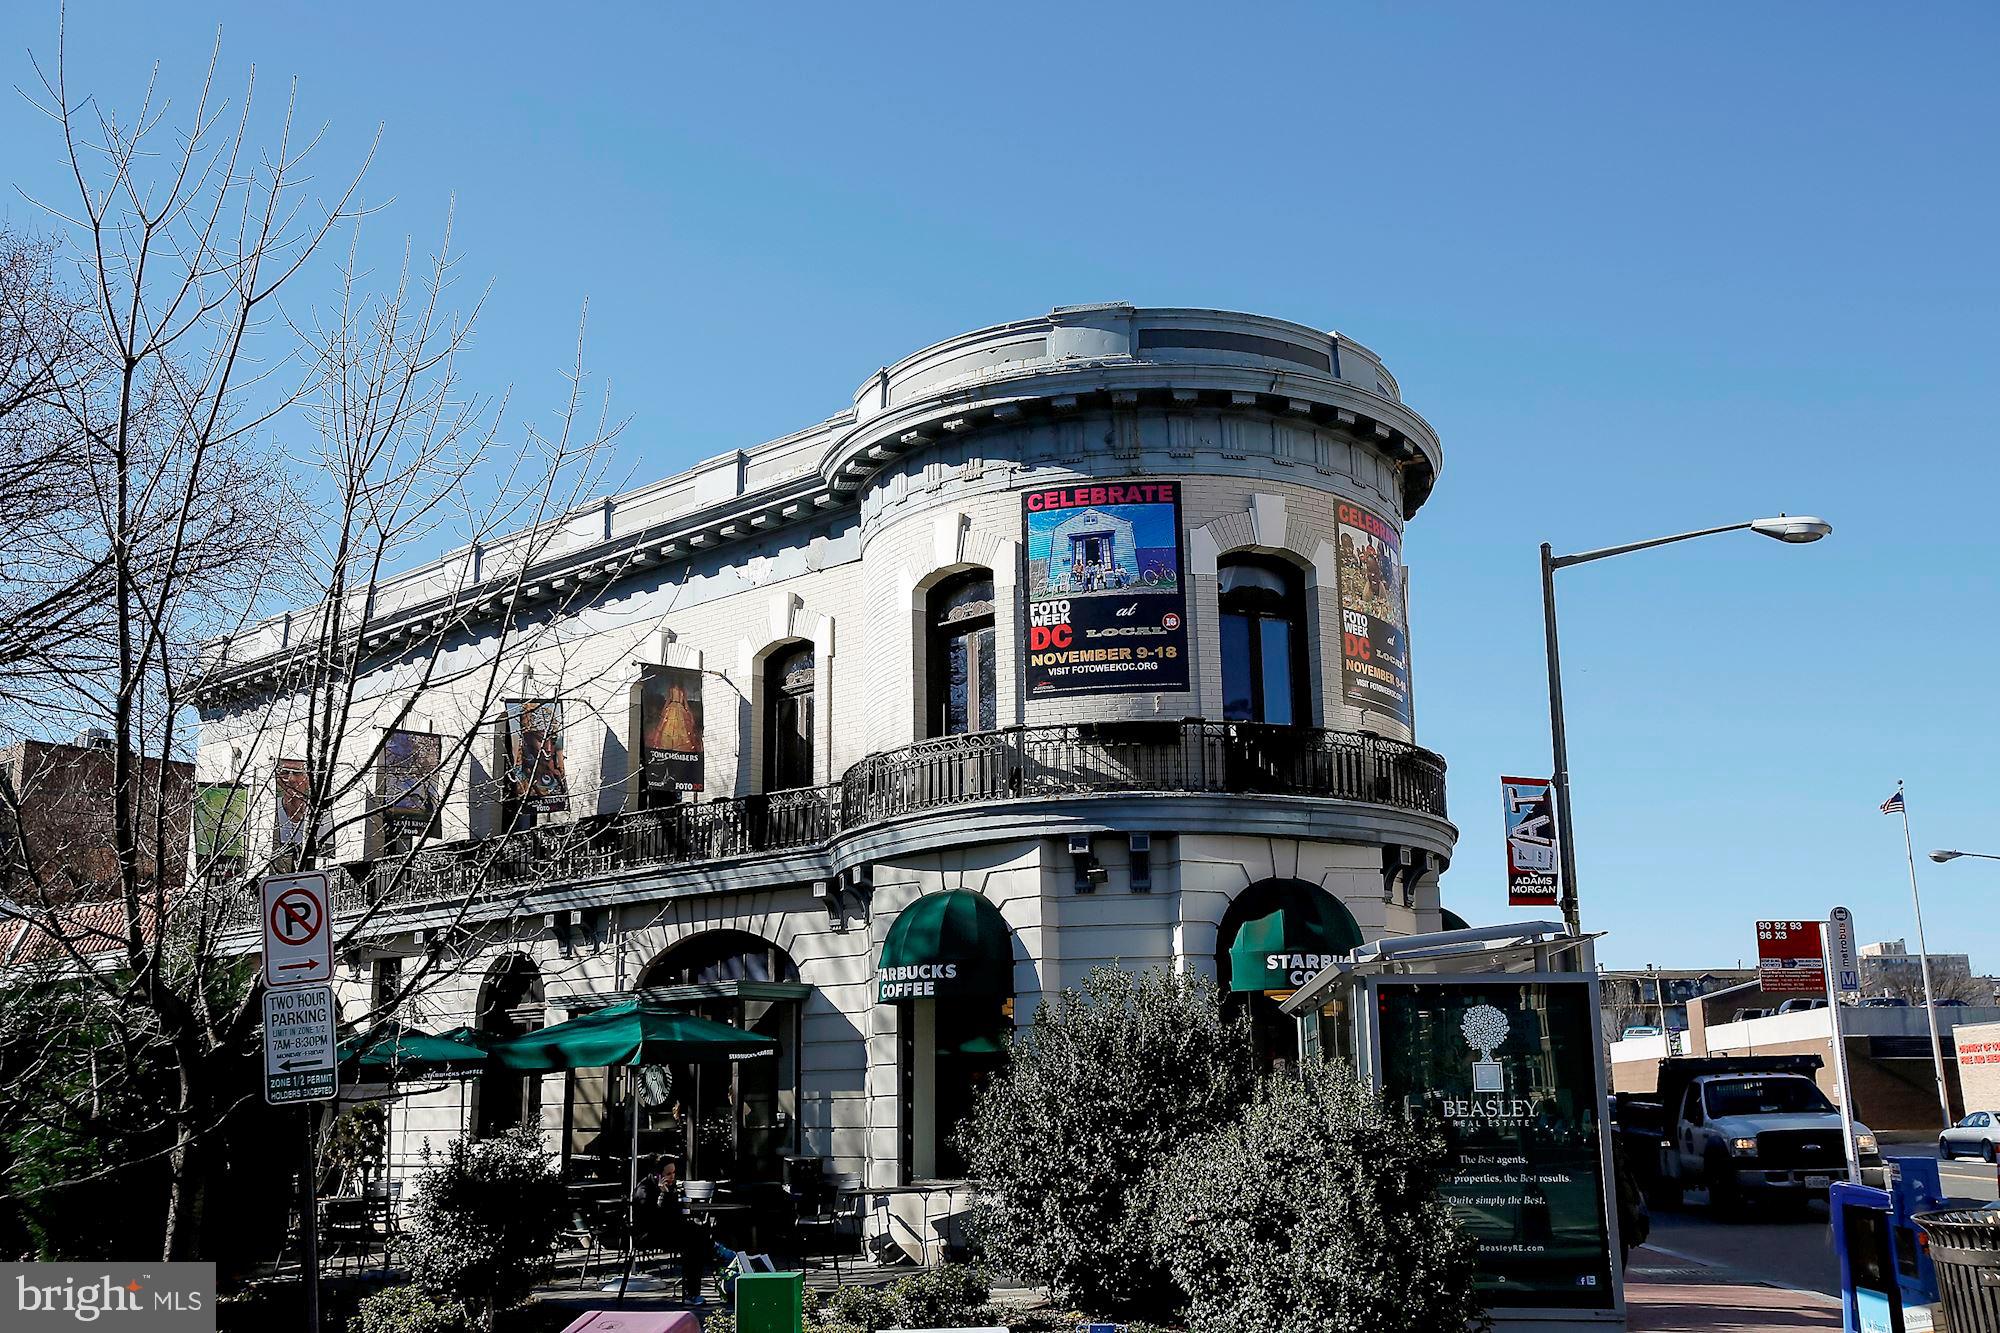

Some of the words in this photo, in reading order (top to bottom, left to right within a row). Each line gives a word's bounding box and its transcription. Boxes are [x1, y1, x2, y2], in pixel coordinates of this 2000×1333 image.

[1027, 485, 1174, 511] CELEBRATE
[1029, 600, 1071, 617] FOTO
[1116, 603, 1138, 617] at
[1030, 612, 1071, 627] WEEK
[1343, 609, 1368, 627] FOTO
[1030, 624, 1073, 651] DC
[1086, 627, 1168, 638] LOCAL
[1344, 622, 1369, 638] WEEK
[1344, 633, 1370, 660] DC
[1031, 648, 1132, 666] NOVEMBER
[1136, 646, 1178, 659] 9-18
[1376, 649, 1404, 670] LOCAL
[1048, 666, 1071, 676] VISIT
[1071, 662, 1158, 674] FOTOWEEKDC.ORG
[1345, 659, 1395, 685] NOVEMBER
[1356, 678, 1369, 689] VISIT
[1515, 876, 1553, 885] ADAMS
[1511, 885, 1556, 894] MORGAN
[1758, 922, 1772, 930] 90
[1774, 922, 1787, 930] 92
[1790, 922, 1802, 930] 93
[1760, 931, 1772, 939] 96
[1775, 931, 1787, 939] X3
[1839, 923, 1849, 967] metrobus
[878, 964, 957, 982] TARBUCKS
[881, 981, 935, 998] COFFEE
[269, 995, 293, 1010] TWO
[298, 992, 326, 1007] HOUR
[271, 1009, 327, 1027] PARKING
[272, 1029, 287, 1037] LIMIT
[289, 1028, 296, 1036] IN
[298, 1026, 313, 1035] ZONE
[315, 1025, 325, 1033] 1/2
[273, 1035, 328, 1050] 7AM-8:30PM
[270, 1078, 291, 1088] ZONE
[293, 1075, 305, 1087] 1/2
[306, 1074, 333, 1085] PERMIT
[270, 1089, 301, 1100] HOLDERS
[302, 1086, 333, 1097] EXCEPTED
[1442, 1099, 1539, 1118] BEASLEY
[1453, 1119, 1481, 1127] REAL
[1488, 1119, 1530, 1127] ESTATE
[1460, 1155, 1476, 1164] The
[1478, 1155, 1495, 1164] Best
[1503, 1173, 1518, 1183] the
[1520, 1173, 1537, 1183] Best
[1539, 1173, 1572, 1183] results.
[1448, 1196, 1474, 1206] Quite
[1475, 1196, 1505, 1207] simply
[1507, 1196, 1522, 1205] the
[1524, 1196, 1546, 1205] Best.
[1477, 1244, 1545, 1253] .BeasleyRE.com
